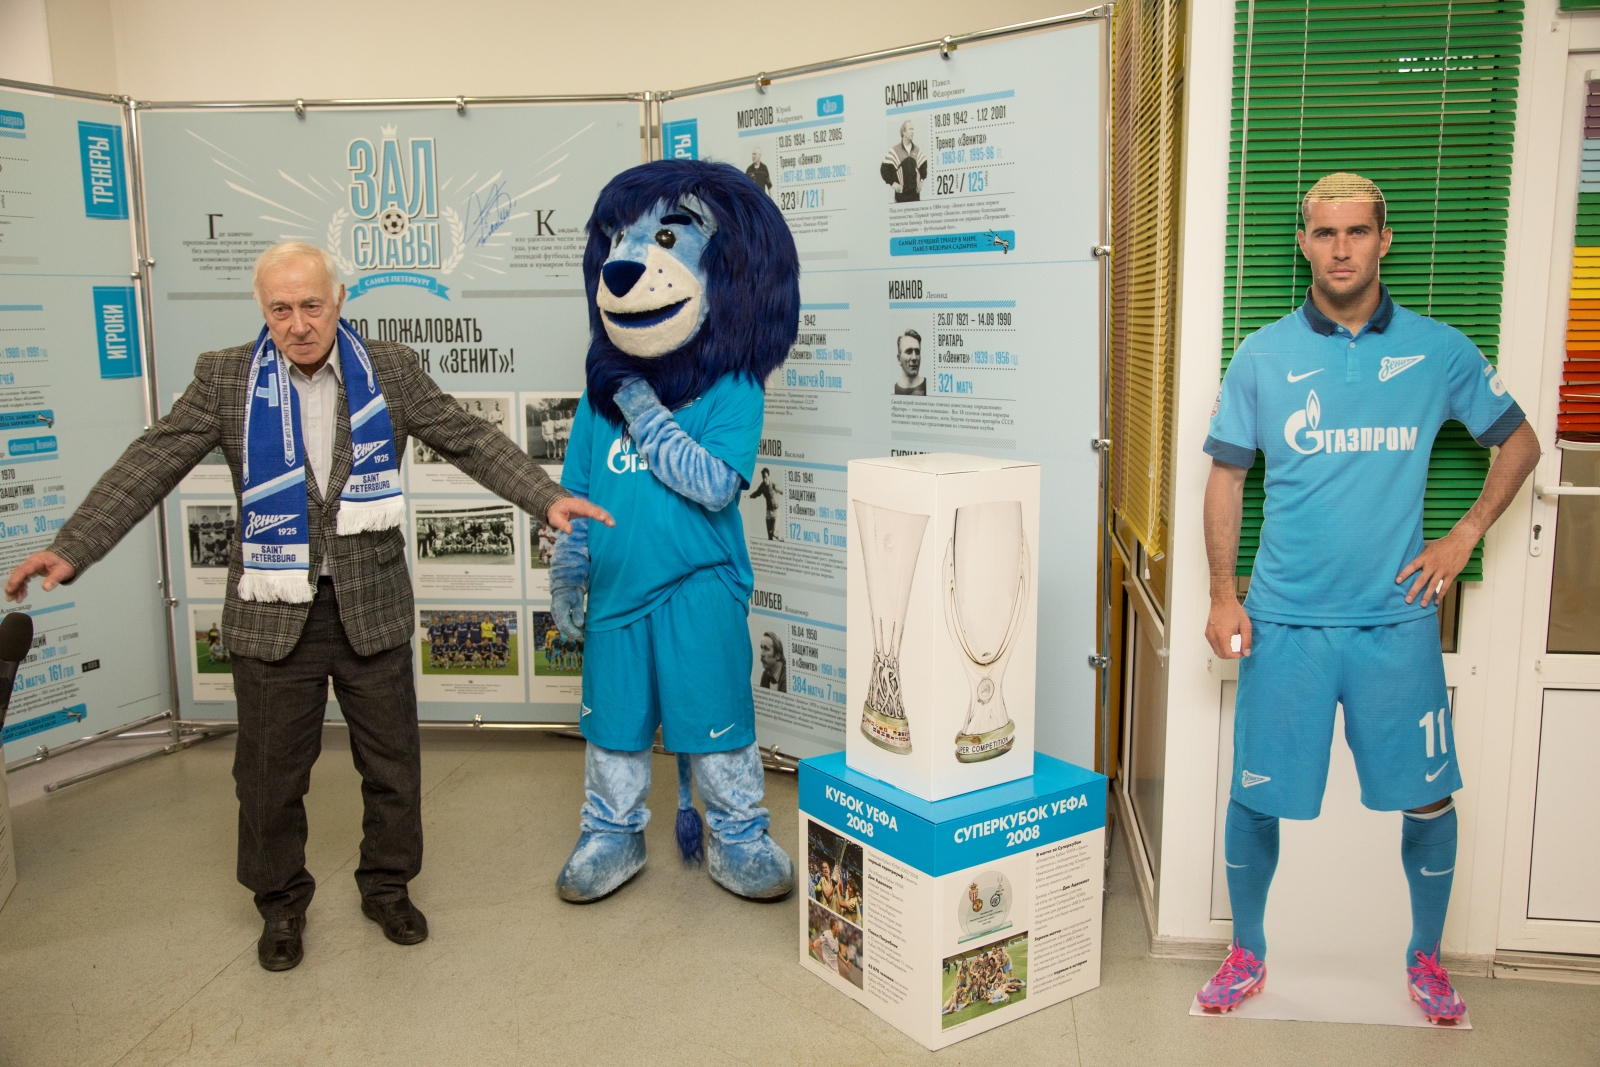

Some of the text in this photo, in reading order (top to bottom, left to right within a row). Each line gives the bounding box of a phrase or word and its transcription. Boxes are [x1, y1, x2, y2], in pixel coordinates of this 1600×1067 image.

[885, 79, 928, 107] САДЫРИН
[737, 106, 774, 129] МОРОЗОВ
[953, 110, 967, 125] 1942
[977, 108, 988, 122] 1.12
[991, 105, 1006, 120] 2001
[935, 133, 987, 150] Тренер «Зенита»
[88, 136, 115, 204] ТРЕНЕРЫ
[347, 137, 440, 220] ЗАЛ
[937, 171, 984, 195] 262 125
[780, 191, 796, 210] 323
[805, 189, 819, 208] 121
[353, 222, 441, 270] СЛАВЫ
[364, 275, 431, 286] САНКТ-ПЕТЕРБУРГ
[889, 280, 948, 299] ИВАНОВ Леонид
[804, 314, 816, 326] 1942
[938, 313, 1012, 326] 25.07 1921 14.09 1990
[103, 304, 128, 360] ИГРОКИ
[378, 318, 483, 343] ПОЖАЛОВАТЬ
[938, 334, 963, 347] ВРАТАРЬ
[439, 348, 515, 374] «ЗЕНИТ»!
[938, 355, 942, 363] в
[943, 351, 970, 364] «Зените»
[995, 351, 1010, 364] 1956
[787, 369, 797, 387] 69
[819, 370, 825, 388] 8
[938, 373, 973, 394] 321 МАТЧ
[1325, 427, 1418, 454] ГАЗПРОМ
[374, 454, 389, 464] 1925
[1, 469, 16, 480] 1970
[363, 473, 380, 484] SAINT
[350, 481, 391, 493] PETERSBURG
[789, 489, 816, 503] ЗАЩИТНИК
[7, 516, 47, 537] МАТЧА 30
[277, 527, 297, 536] 1925
[789, 523, 801, 541] 172
[803, 530, 820, 544] МАТЧА
[823, 527, 829, 545] 6
[251, 553, 296, 563] PETERSBURG
[261, 545, 283, 555] SAINT
[791, 625, 818, 640] 16.04 1950
[792, 643, 818, 659] ЗАЩИТНИК
[25, 674, 47, 689] МАТЧА
[48, 664, 63, 683] 161
[792, 675, 832, 700] 384 МАТЧА 7
[1419, 708, 1447, 758] 11
[971, 736, 1009, 753] COMPETITION
[825, 785, 899, 832] КУБОК УЕФА
[954, 794, 1088, 844] СУПЕРКУБОК УЕФА
[846, 812, 874, 838] 2008
[1006, 824, 1040, 847] 2008
